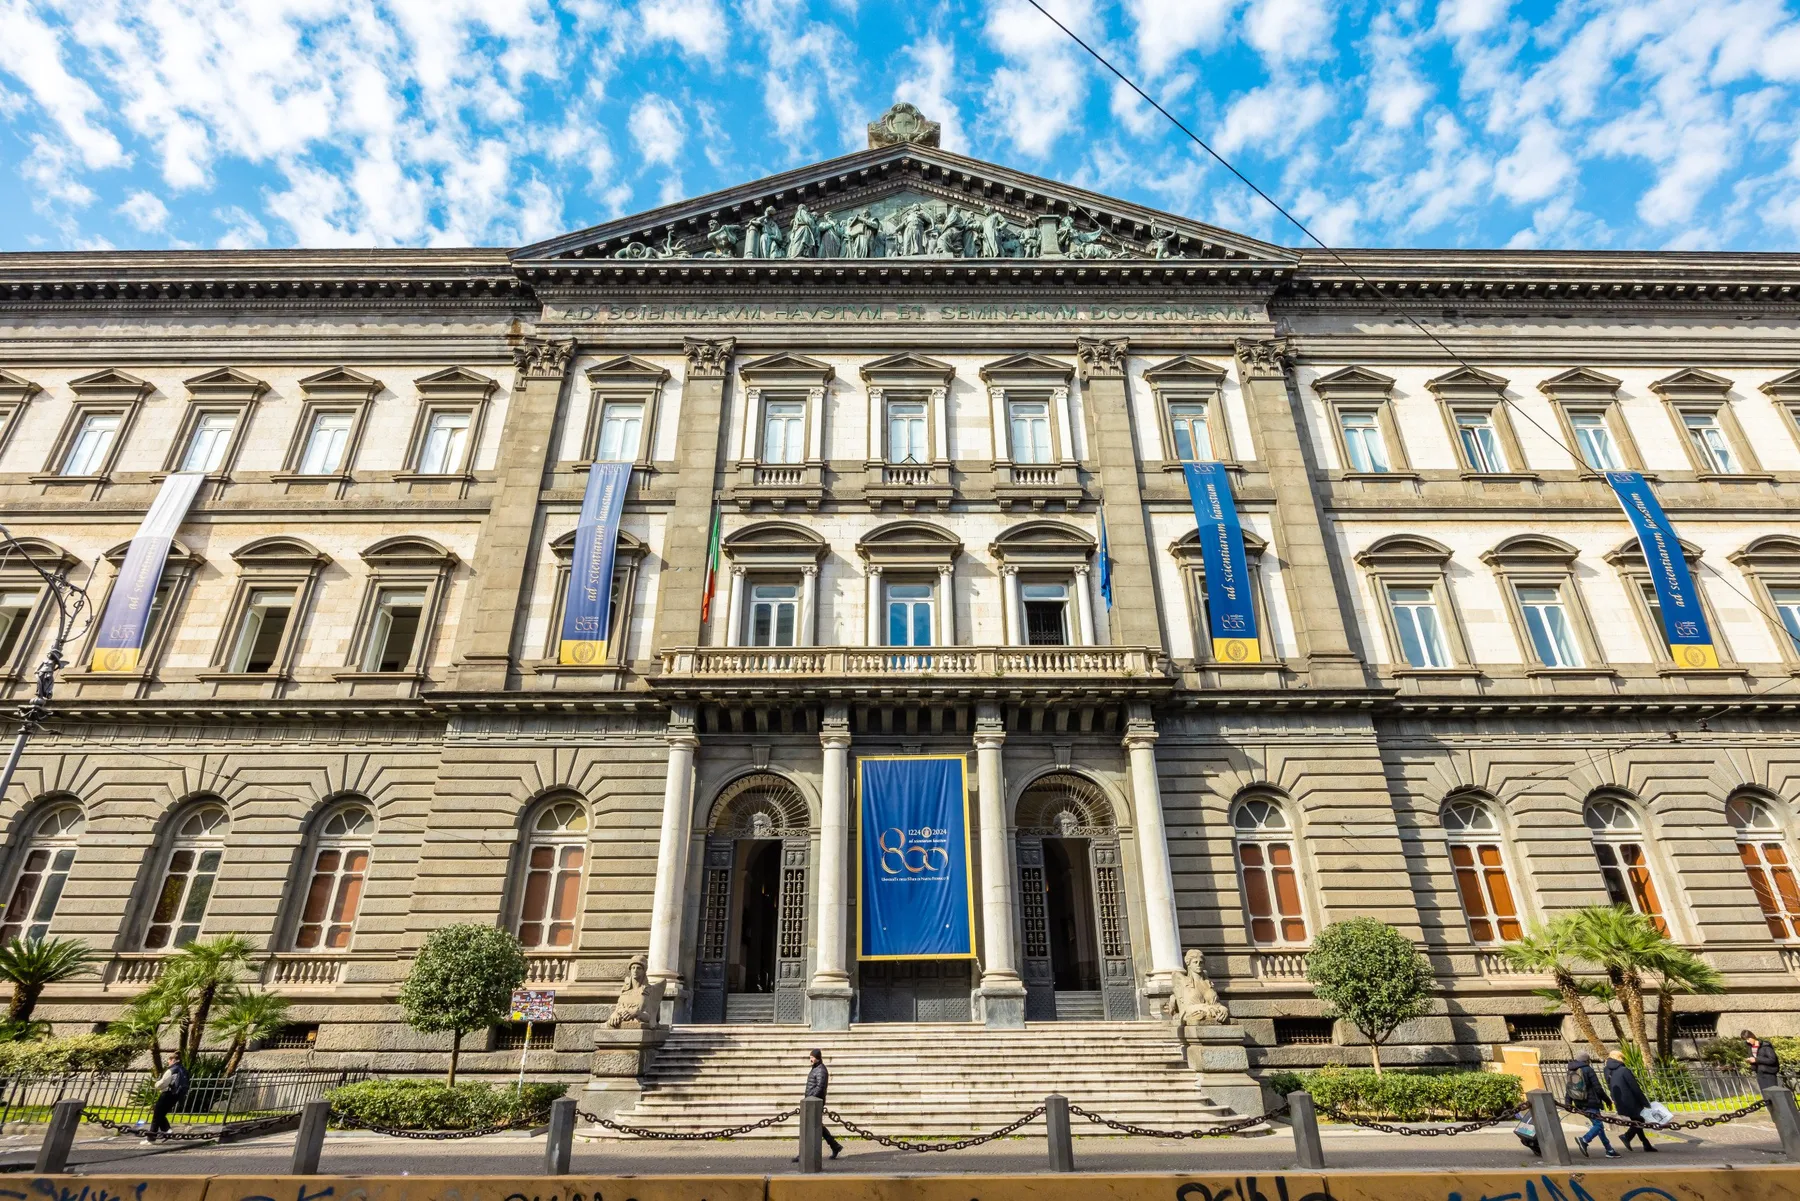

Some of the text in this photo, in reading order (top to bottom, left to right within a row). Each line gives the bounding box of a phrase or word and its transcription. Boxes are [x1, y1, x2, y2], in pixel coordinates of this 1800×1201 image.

[594, 484, 613, 521] haustum
[588, 524, 605, 584] scientiarum
[1207, 483, 1236, 600] ad scientiarum haustum
[1654, 531, 1680, 591] scientiarum
[127, 595, 139, 610] ad
[584, 585, 597, 601] ad
[1668, 591, 1685, 608] ad
[932, 828, 947, 836] 2024
